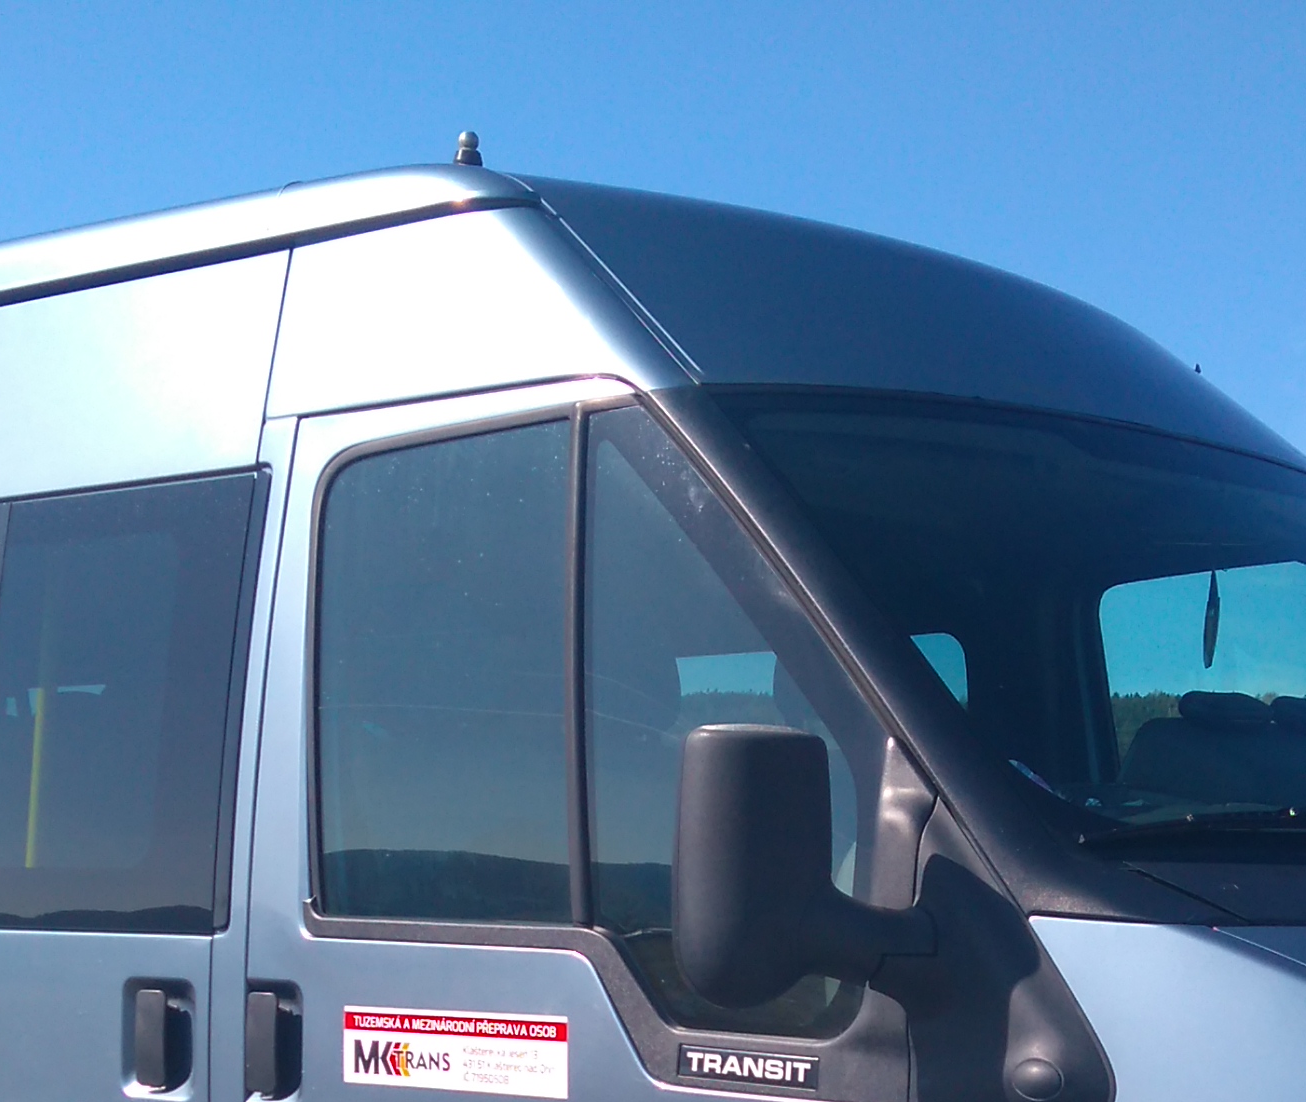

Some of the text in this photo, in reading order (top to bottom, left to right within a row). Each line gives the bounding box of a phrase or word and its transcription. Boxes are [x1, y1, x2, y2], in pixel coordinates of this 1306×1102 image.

[353, 1015, 557, 1038] TUZEMSKÁ A MEZINÁRODNÍ PŘEPRAVA OSOB
[686, 1051, 811, 1083] TRANSIT
